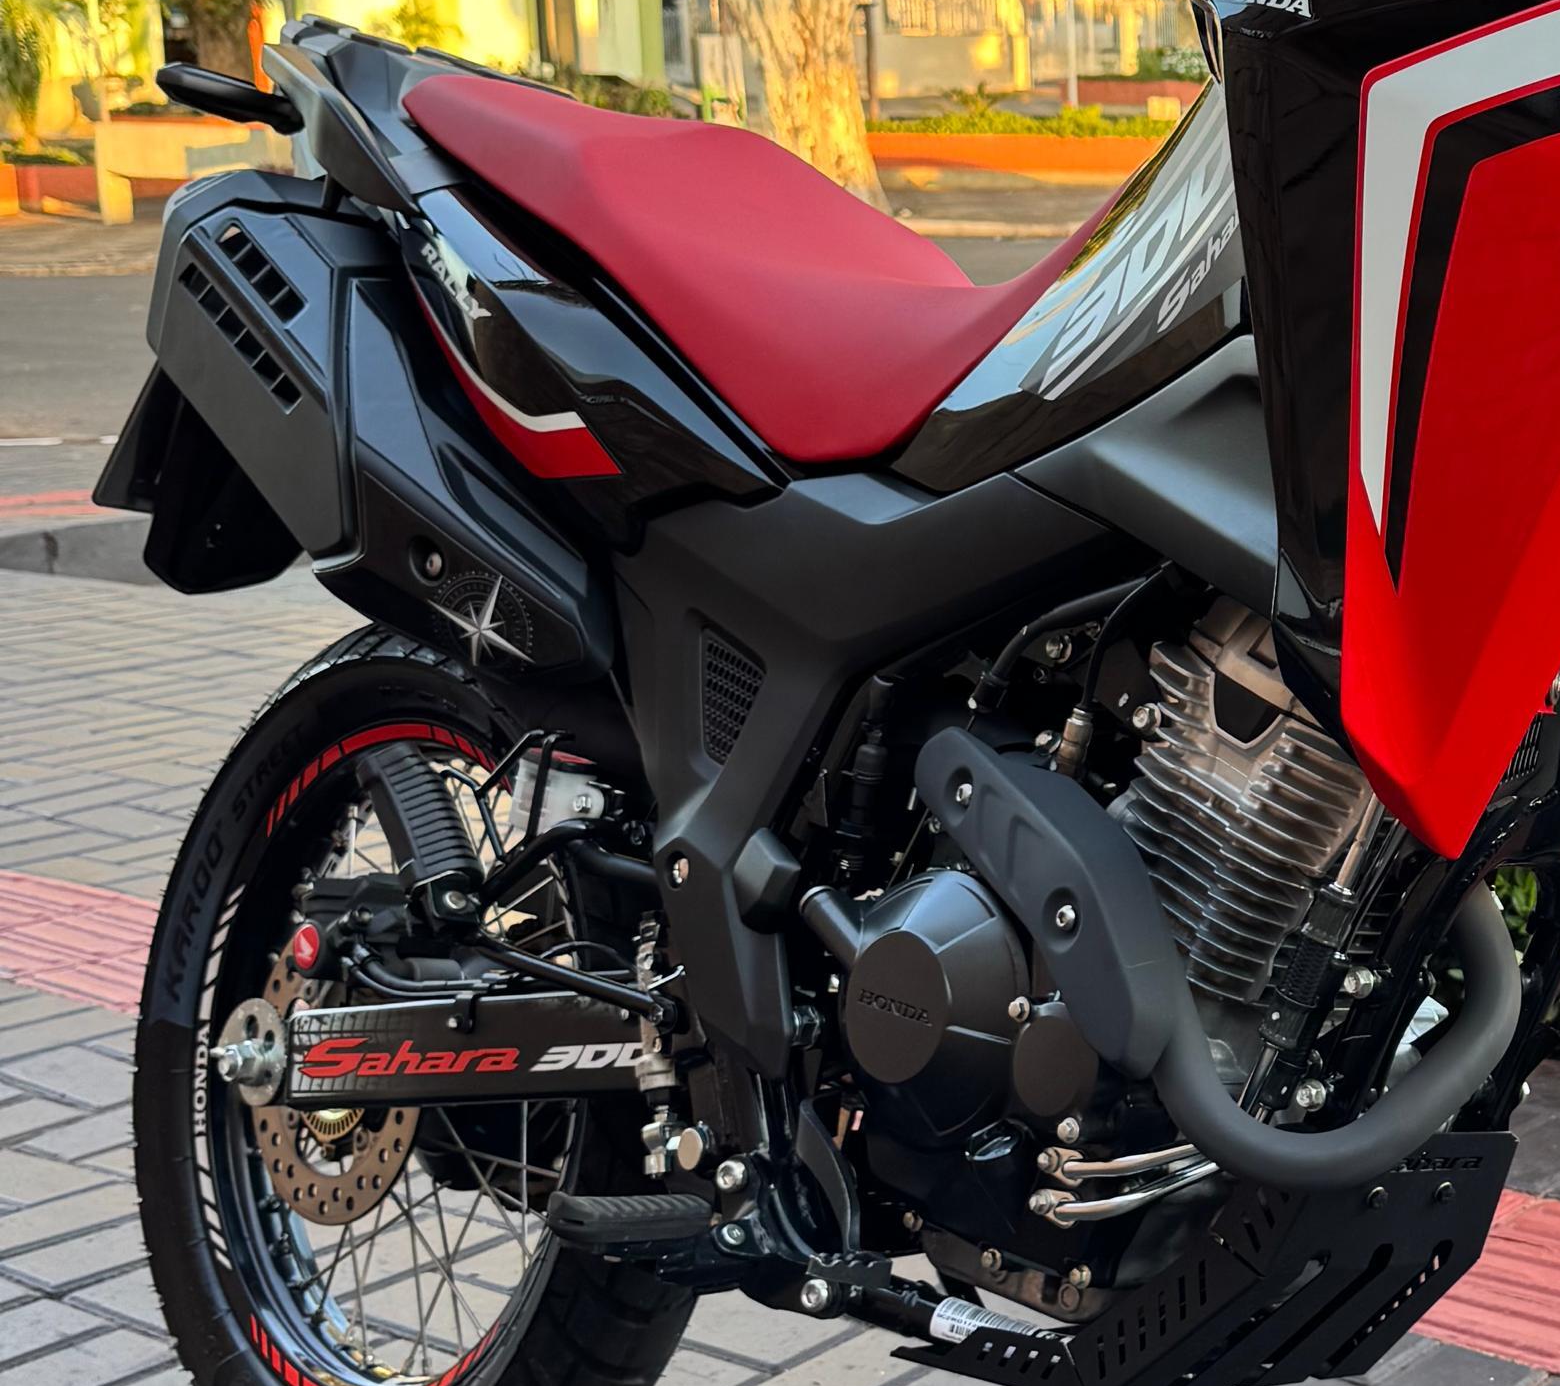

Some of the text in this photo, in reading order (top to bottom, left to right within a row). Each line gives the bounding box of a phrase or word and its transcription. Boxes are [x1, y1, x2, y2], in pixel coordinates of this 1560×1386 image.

[421, 242, 493, 321] RALLY
[232, 723, 306, 823] STREET
[859, 989, 933, 1026] HONDA
[193, 1022, 210, 1133] HONDA
[300, 1037, 519, 1079] Sahara
[1389, 1153, 1484, 1172] ahara
